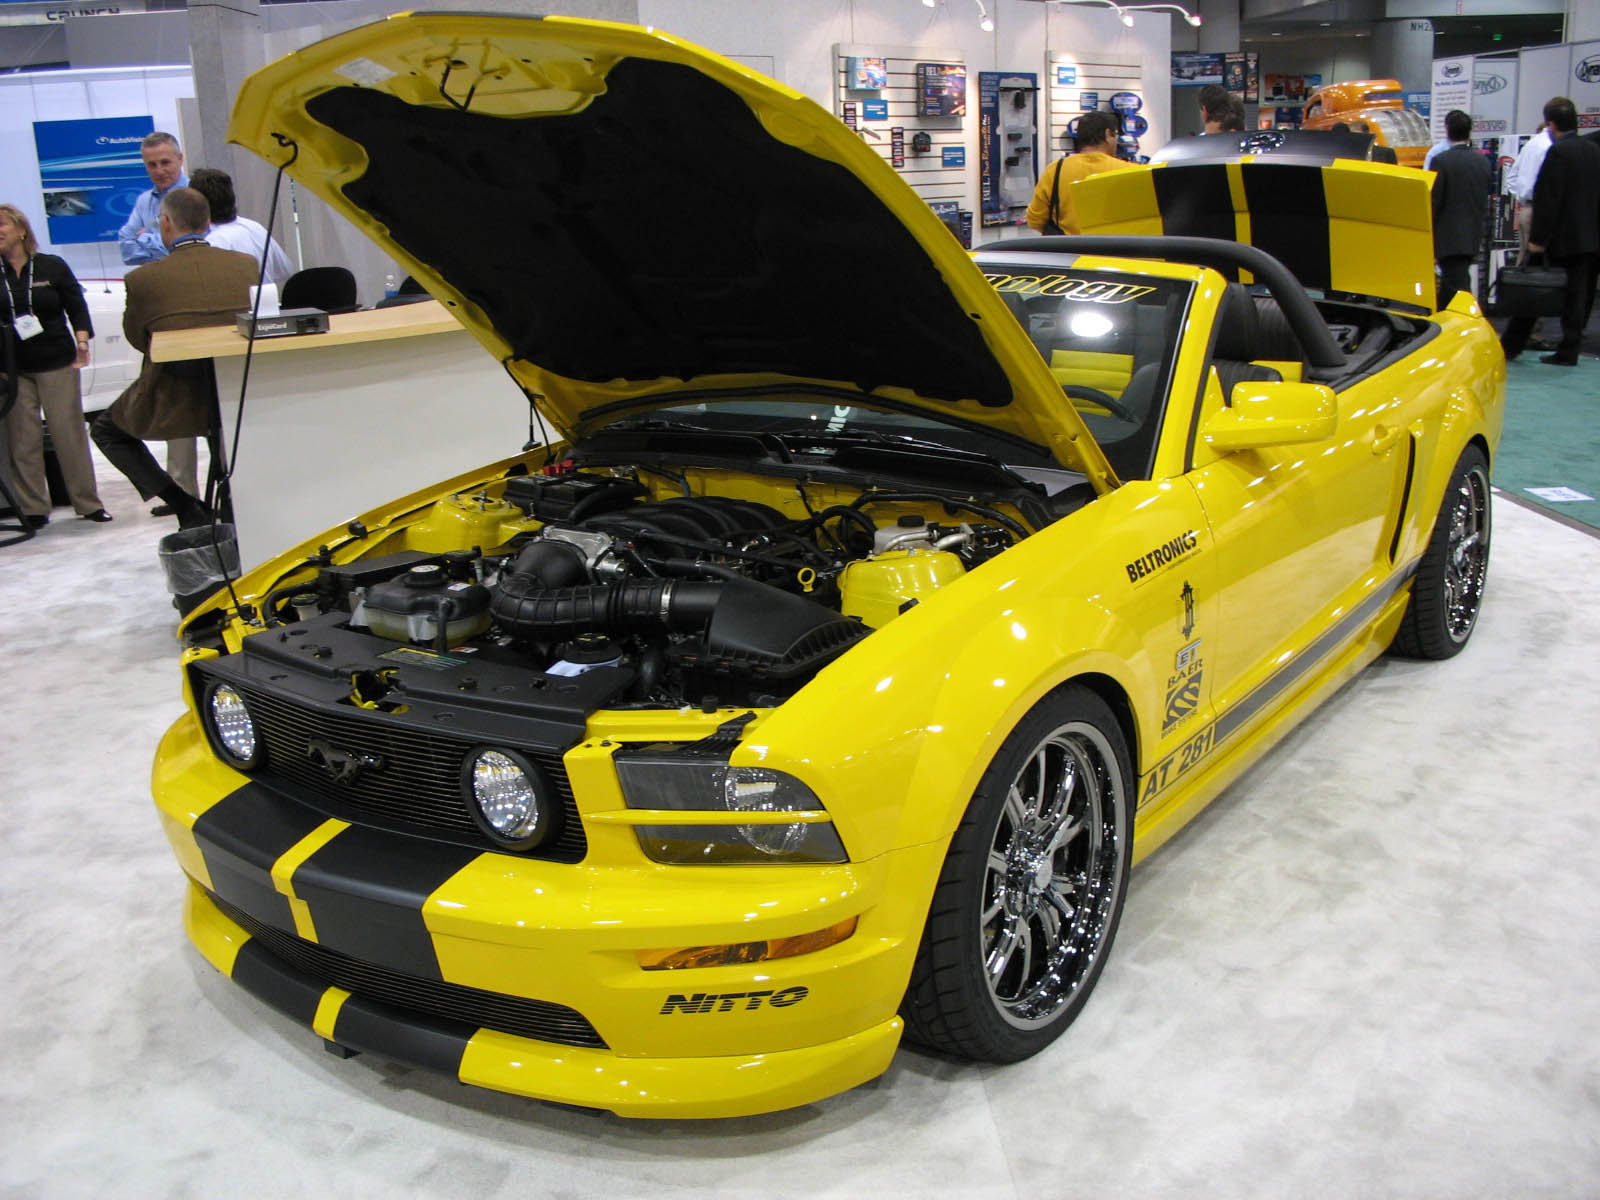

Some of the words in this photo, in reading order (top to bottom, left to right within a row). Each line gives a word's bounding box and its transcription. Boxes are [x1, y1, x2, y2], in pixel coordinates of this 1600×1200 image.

[1126, 530, 1197, 583] BELTRONICS
[1167, 658, 1203, 689] BAER
[1141, 757, 1174, 803] AT
[1178, 726, 1213, 774] 281
[659, 986, 809, 1015] NITTO
